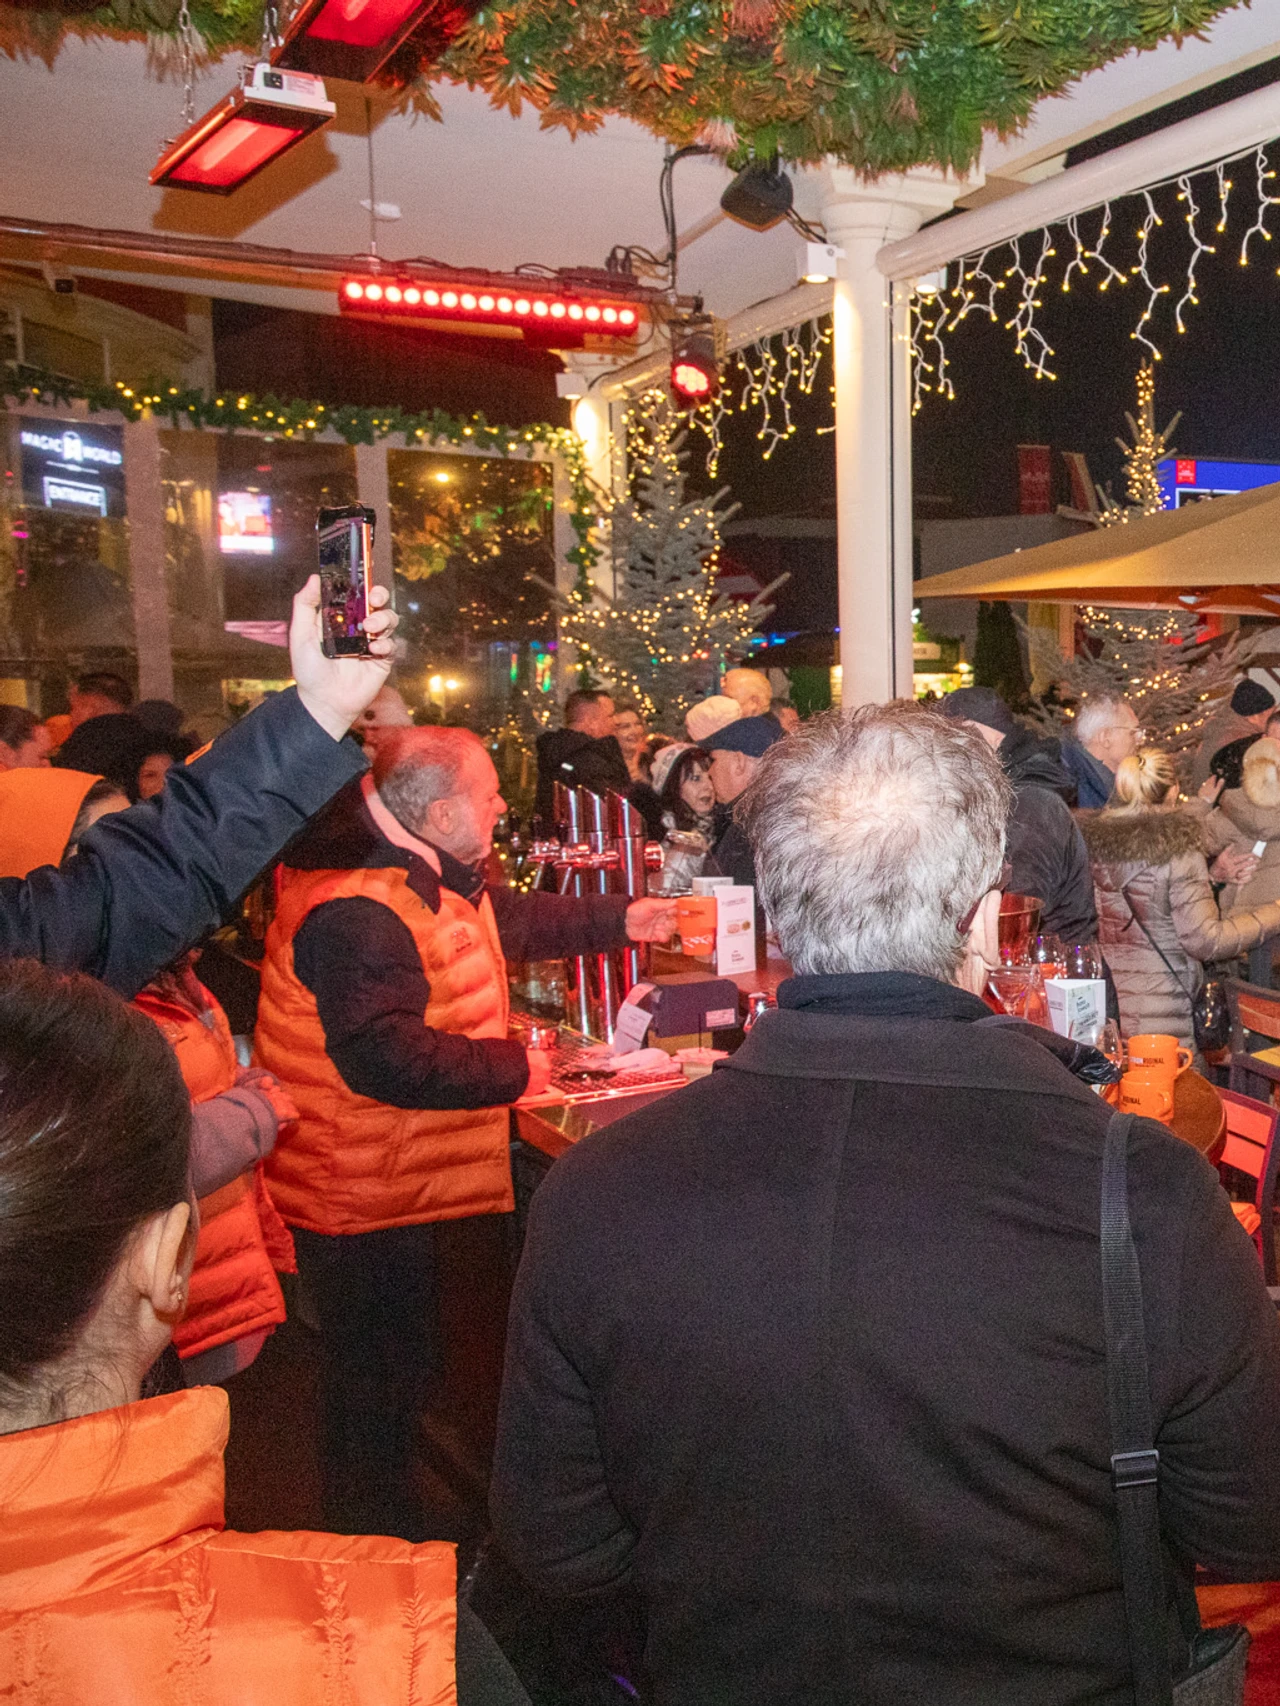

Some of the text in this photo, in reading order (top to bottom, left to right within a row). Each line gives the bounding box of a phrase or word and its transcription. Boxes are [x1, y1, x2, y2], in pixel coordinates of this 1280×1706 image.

[21, 431, 122, 465] MAGIC WORLD
[49, 484, 100, 507] ENTRANCE
